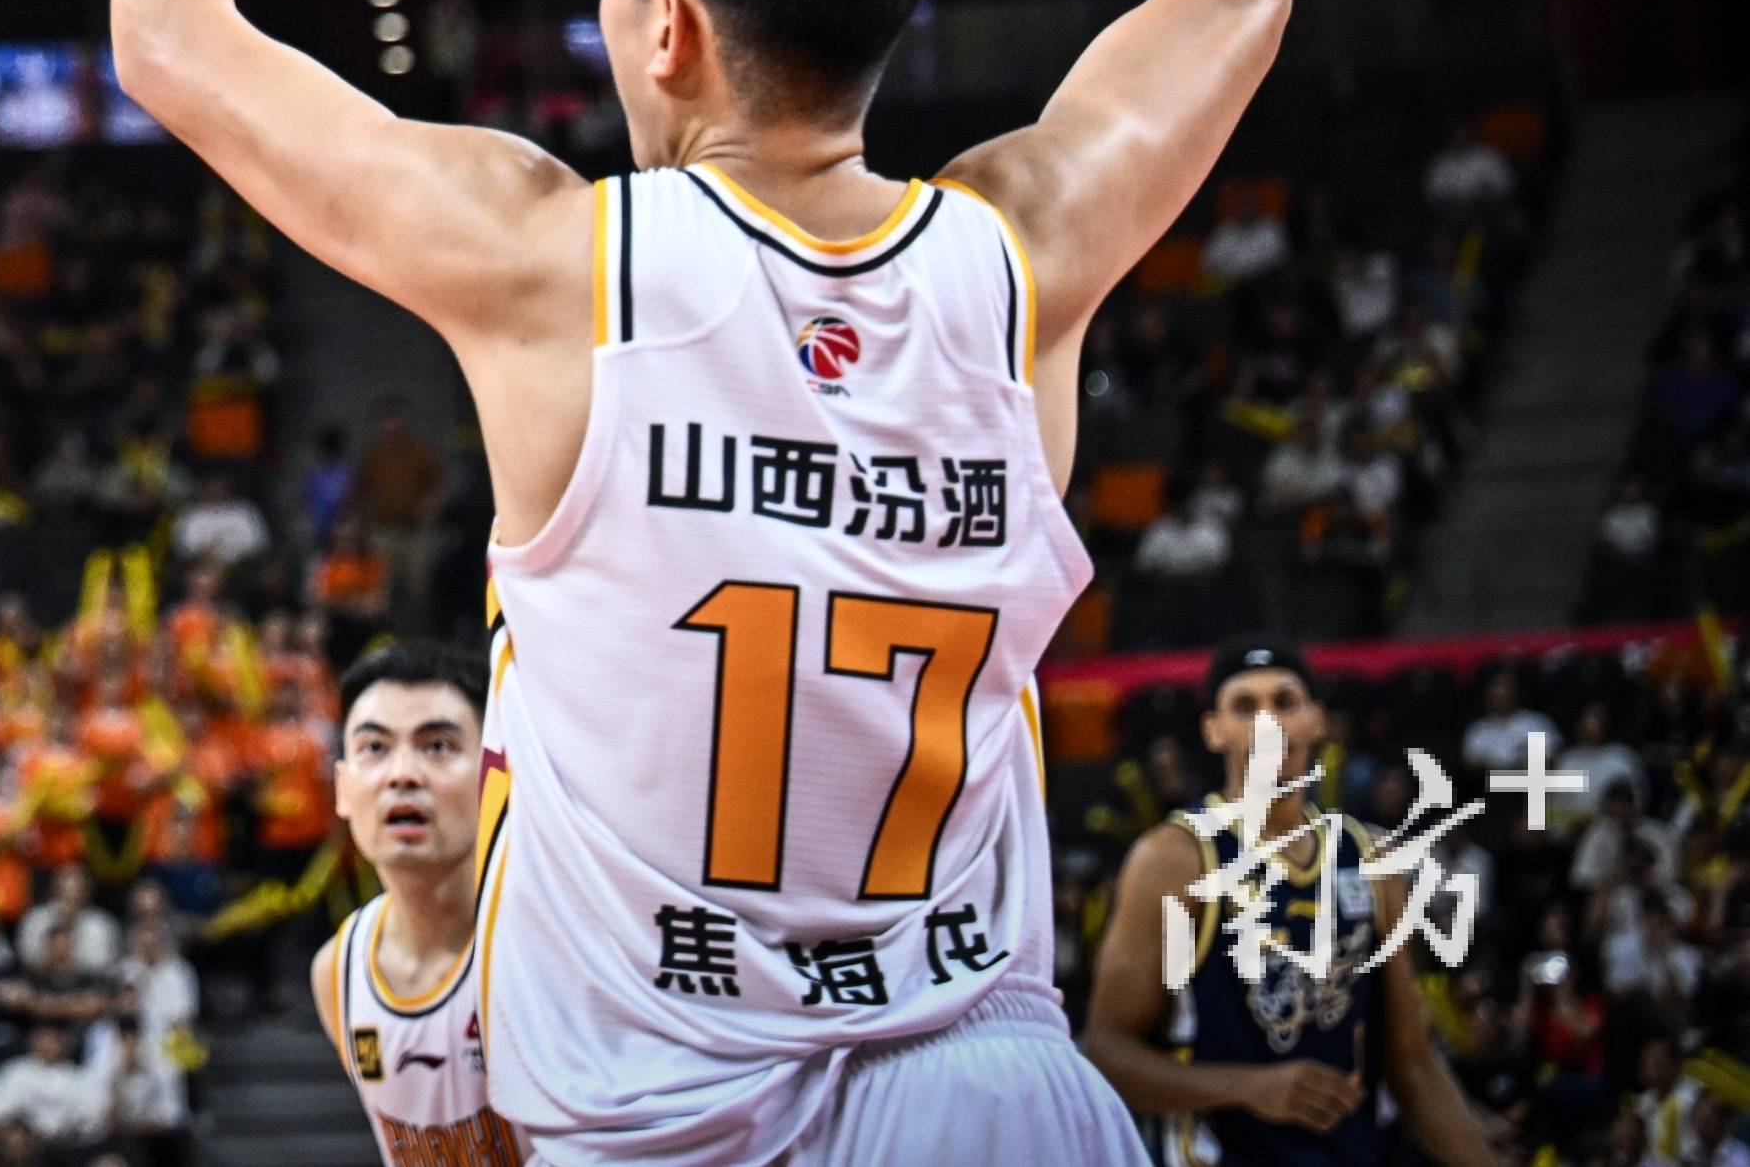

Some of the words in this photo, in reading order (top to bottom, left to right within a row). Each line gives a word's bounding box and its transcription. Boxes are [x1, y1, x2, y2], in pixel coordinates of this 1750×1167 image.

[647, 422, 1007, 547] 山西汾酒
[672, 580, 999, 901] 17
